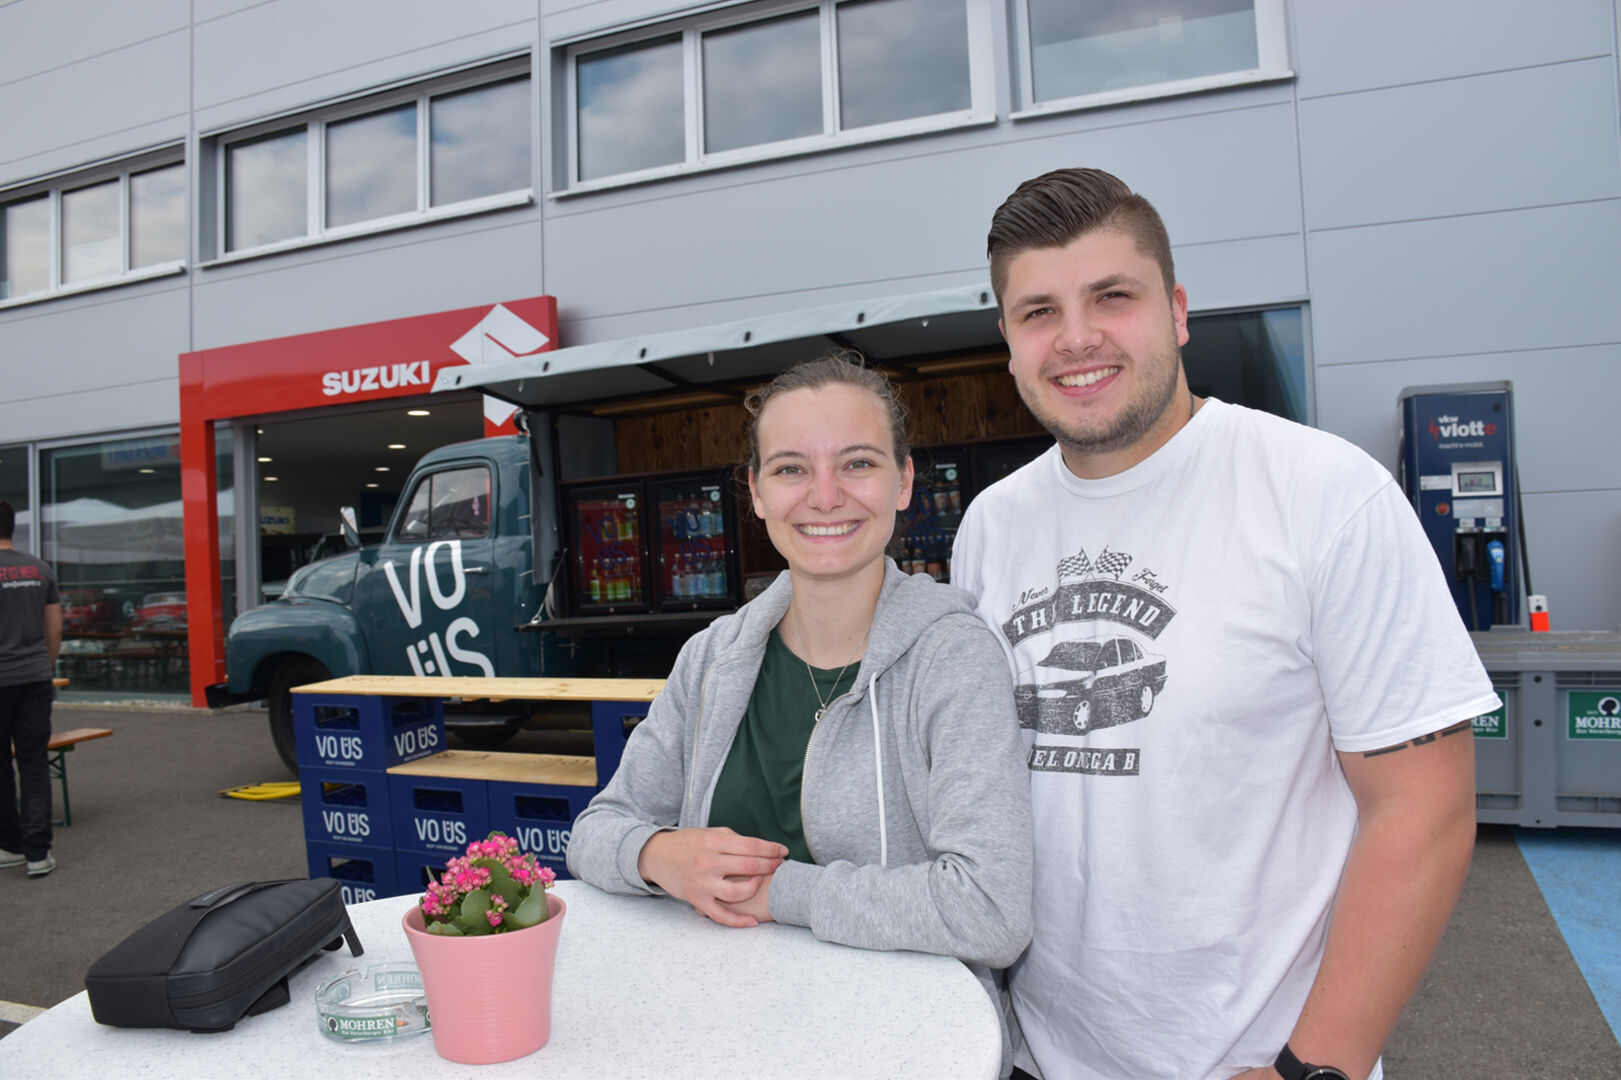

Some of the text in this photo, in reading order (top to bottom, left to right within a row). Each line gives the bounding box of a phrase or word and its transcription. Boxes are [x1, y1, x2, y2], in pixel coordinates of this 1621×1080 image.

[322, 361, 430, 396] SUZUKI
[1438, 414, 1459, 424] vkw
[1440, 421, 1497, 438] vlotte
[384, 540, 466, 629] VO
[1012, 568, 1168, 611] Never Forget
[1072, 592, 1160, 626] LEGEND
[1575, 716, 1621, 728] MOHR
[315, 735, 338, 758] VO
[394, 731, 415, 756] VO
[322, 810, 345, 834] VO
[414, 818, 440, 842] VO
[516, 826, 544, 852] VO
[340, 1018, 394, 1030] MOHREN
